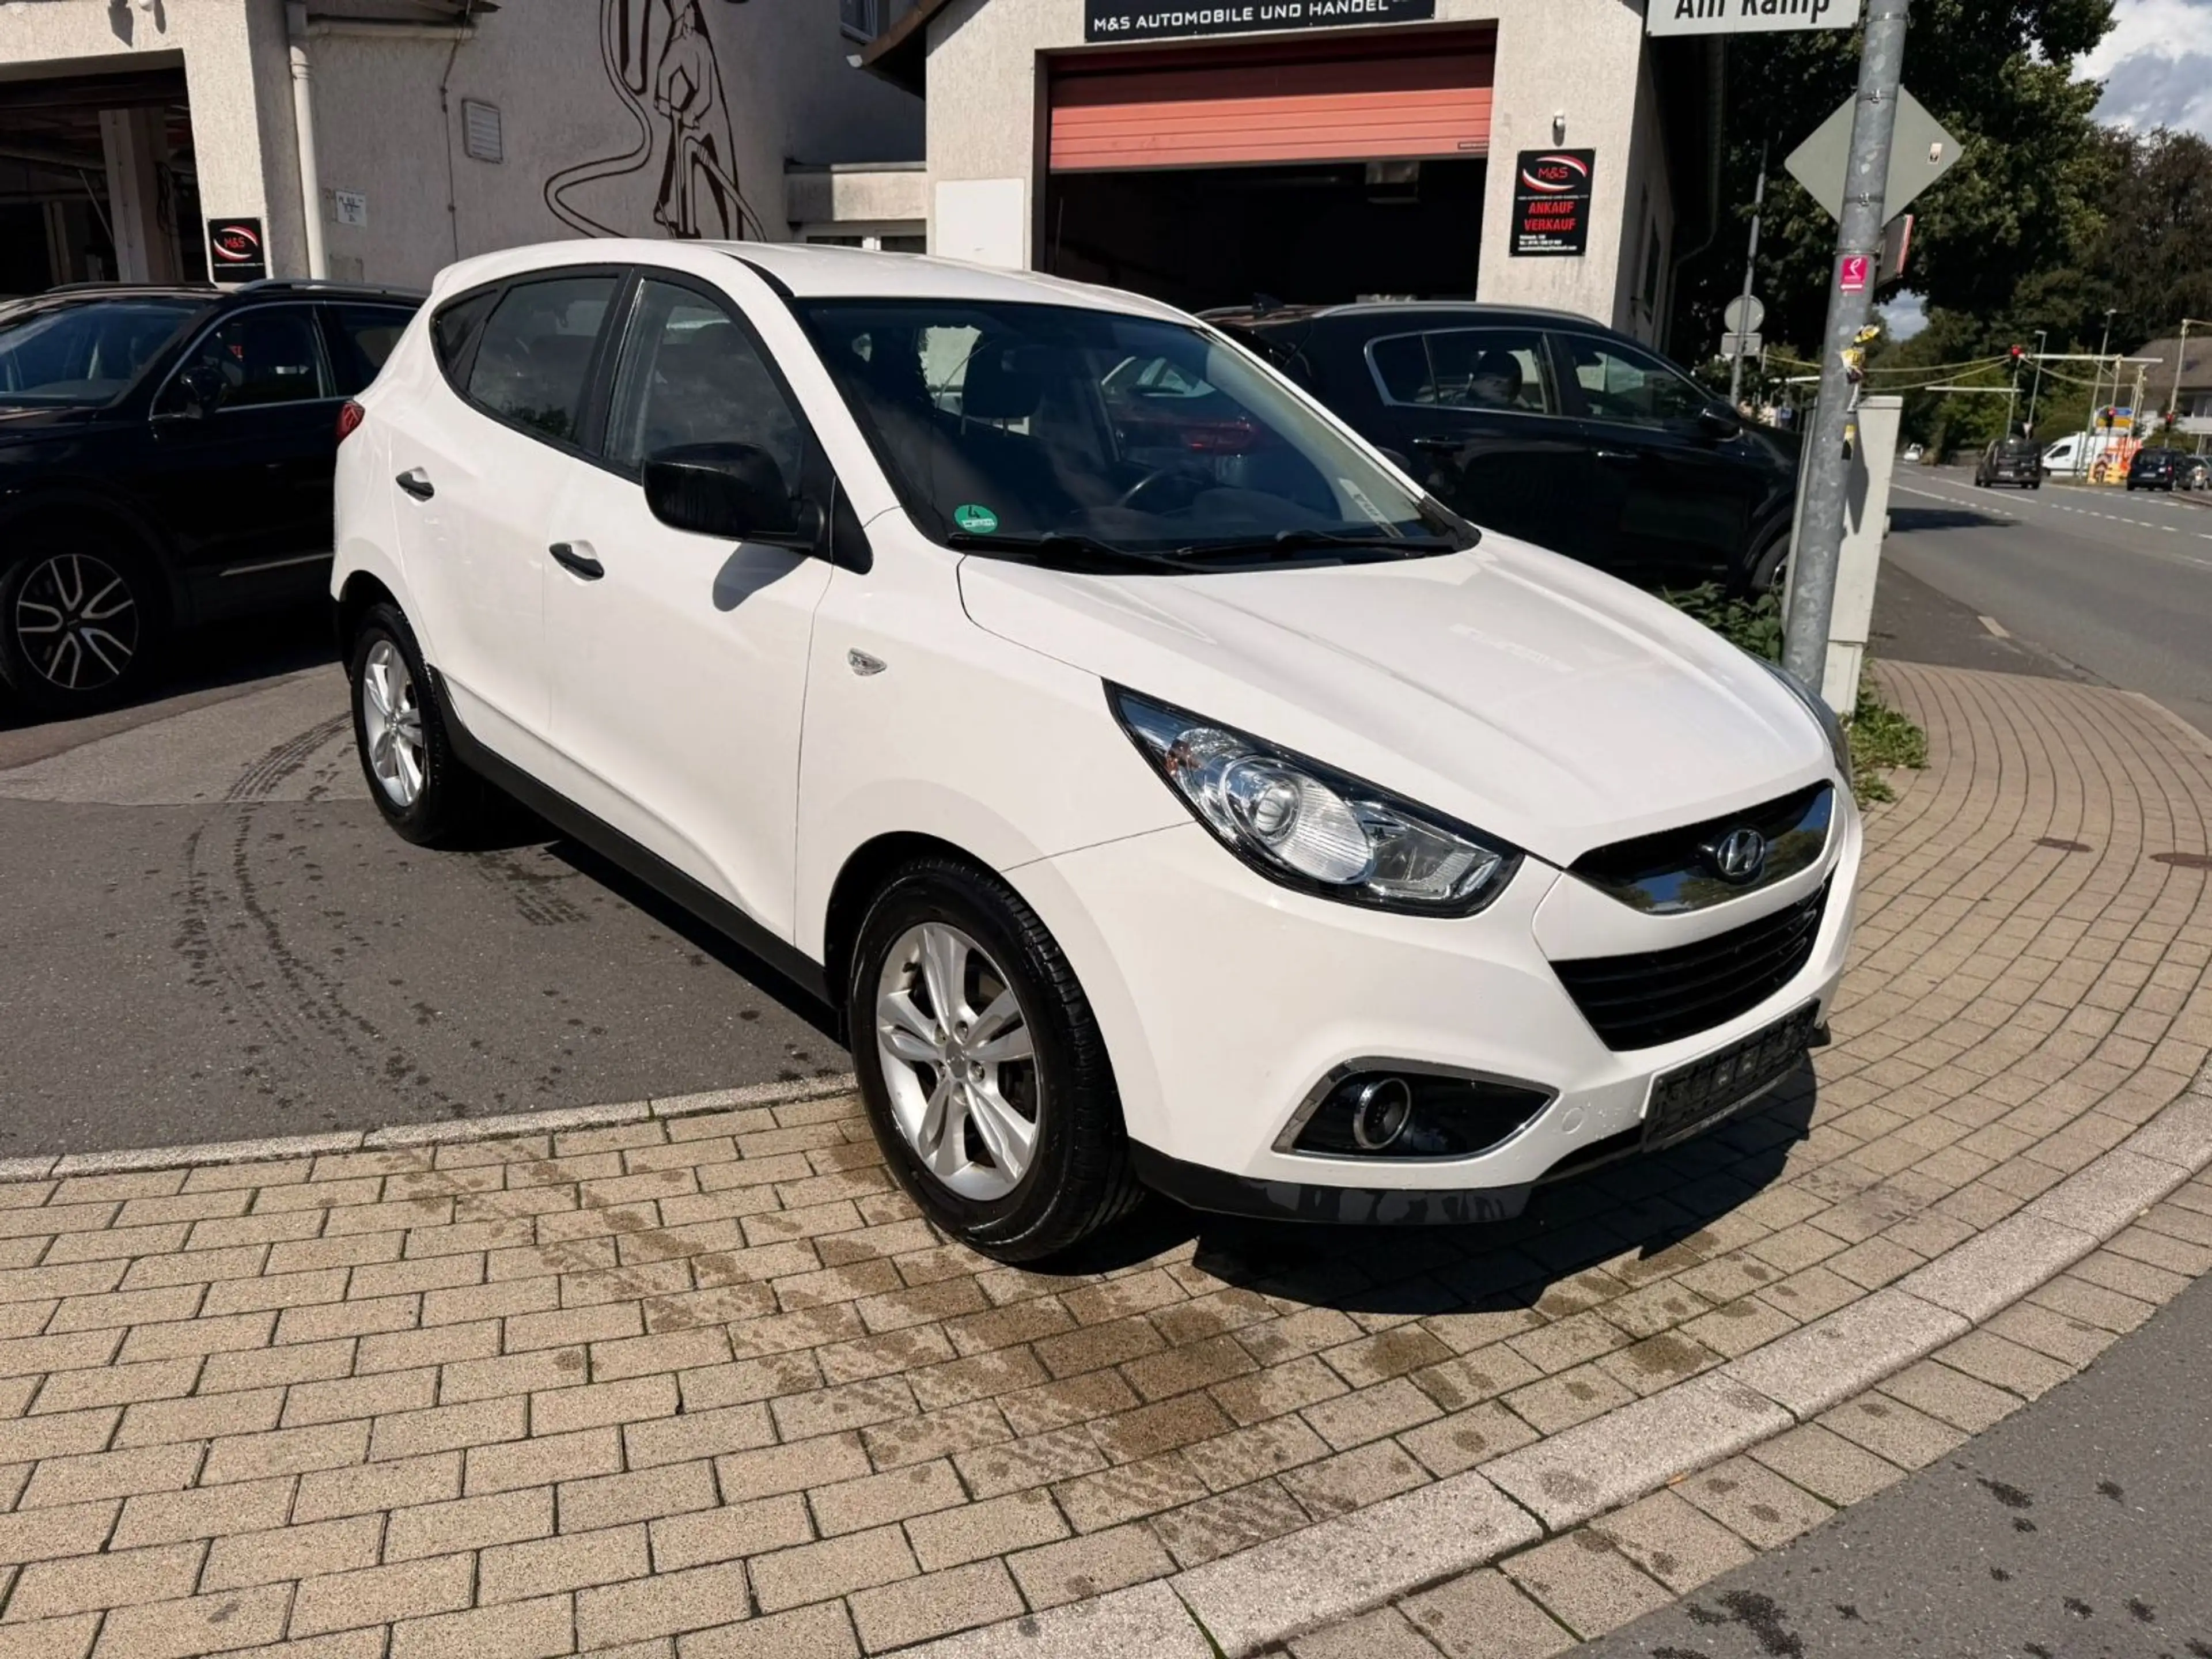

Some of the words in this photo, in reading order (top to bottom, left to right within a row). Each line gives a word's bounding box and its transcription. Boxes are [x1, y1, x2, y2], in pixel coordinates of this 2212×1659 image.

[1094, 17, 1130, 32] M&S
[1135, 7, 1254, 29] AUTOMOBILE
[1260, 4, 1302, 20] UND
[1309, 0, 1389, 17] HANDEL
[1539, 167, 1569, 179] M&S
[1528, 202, 1574, 214] ANKAUF
[1524, 218, 1577, 231] VERKAUF
[224, 236, 245, 248] M&S
[968, 506, 980, 518] 4
